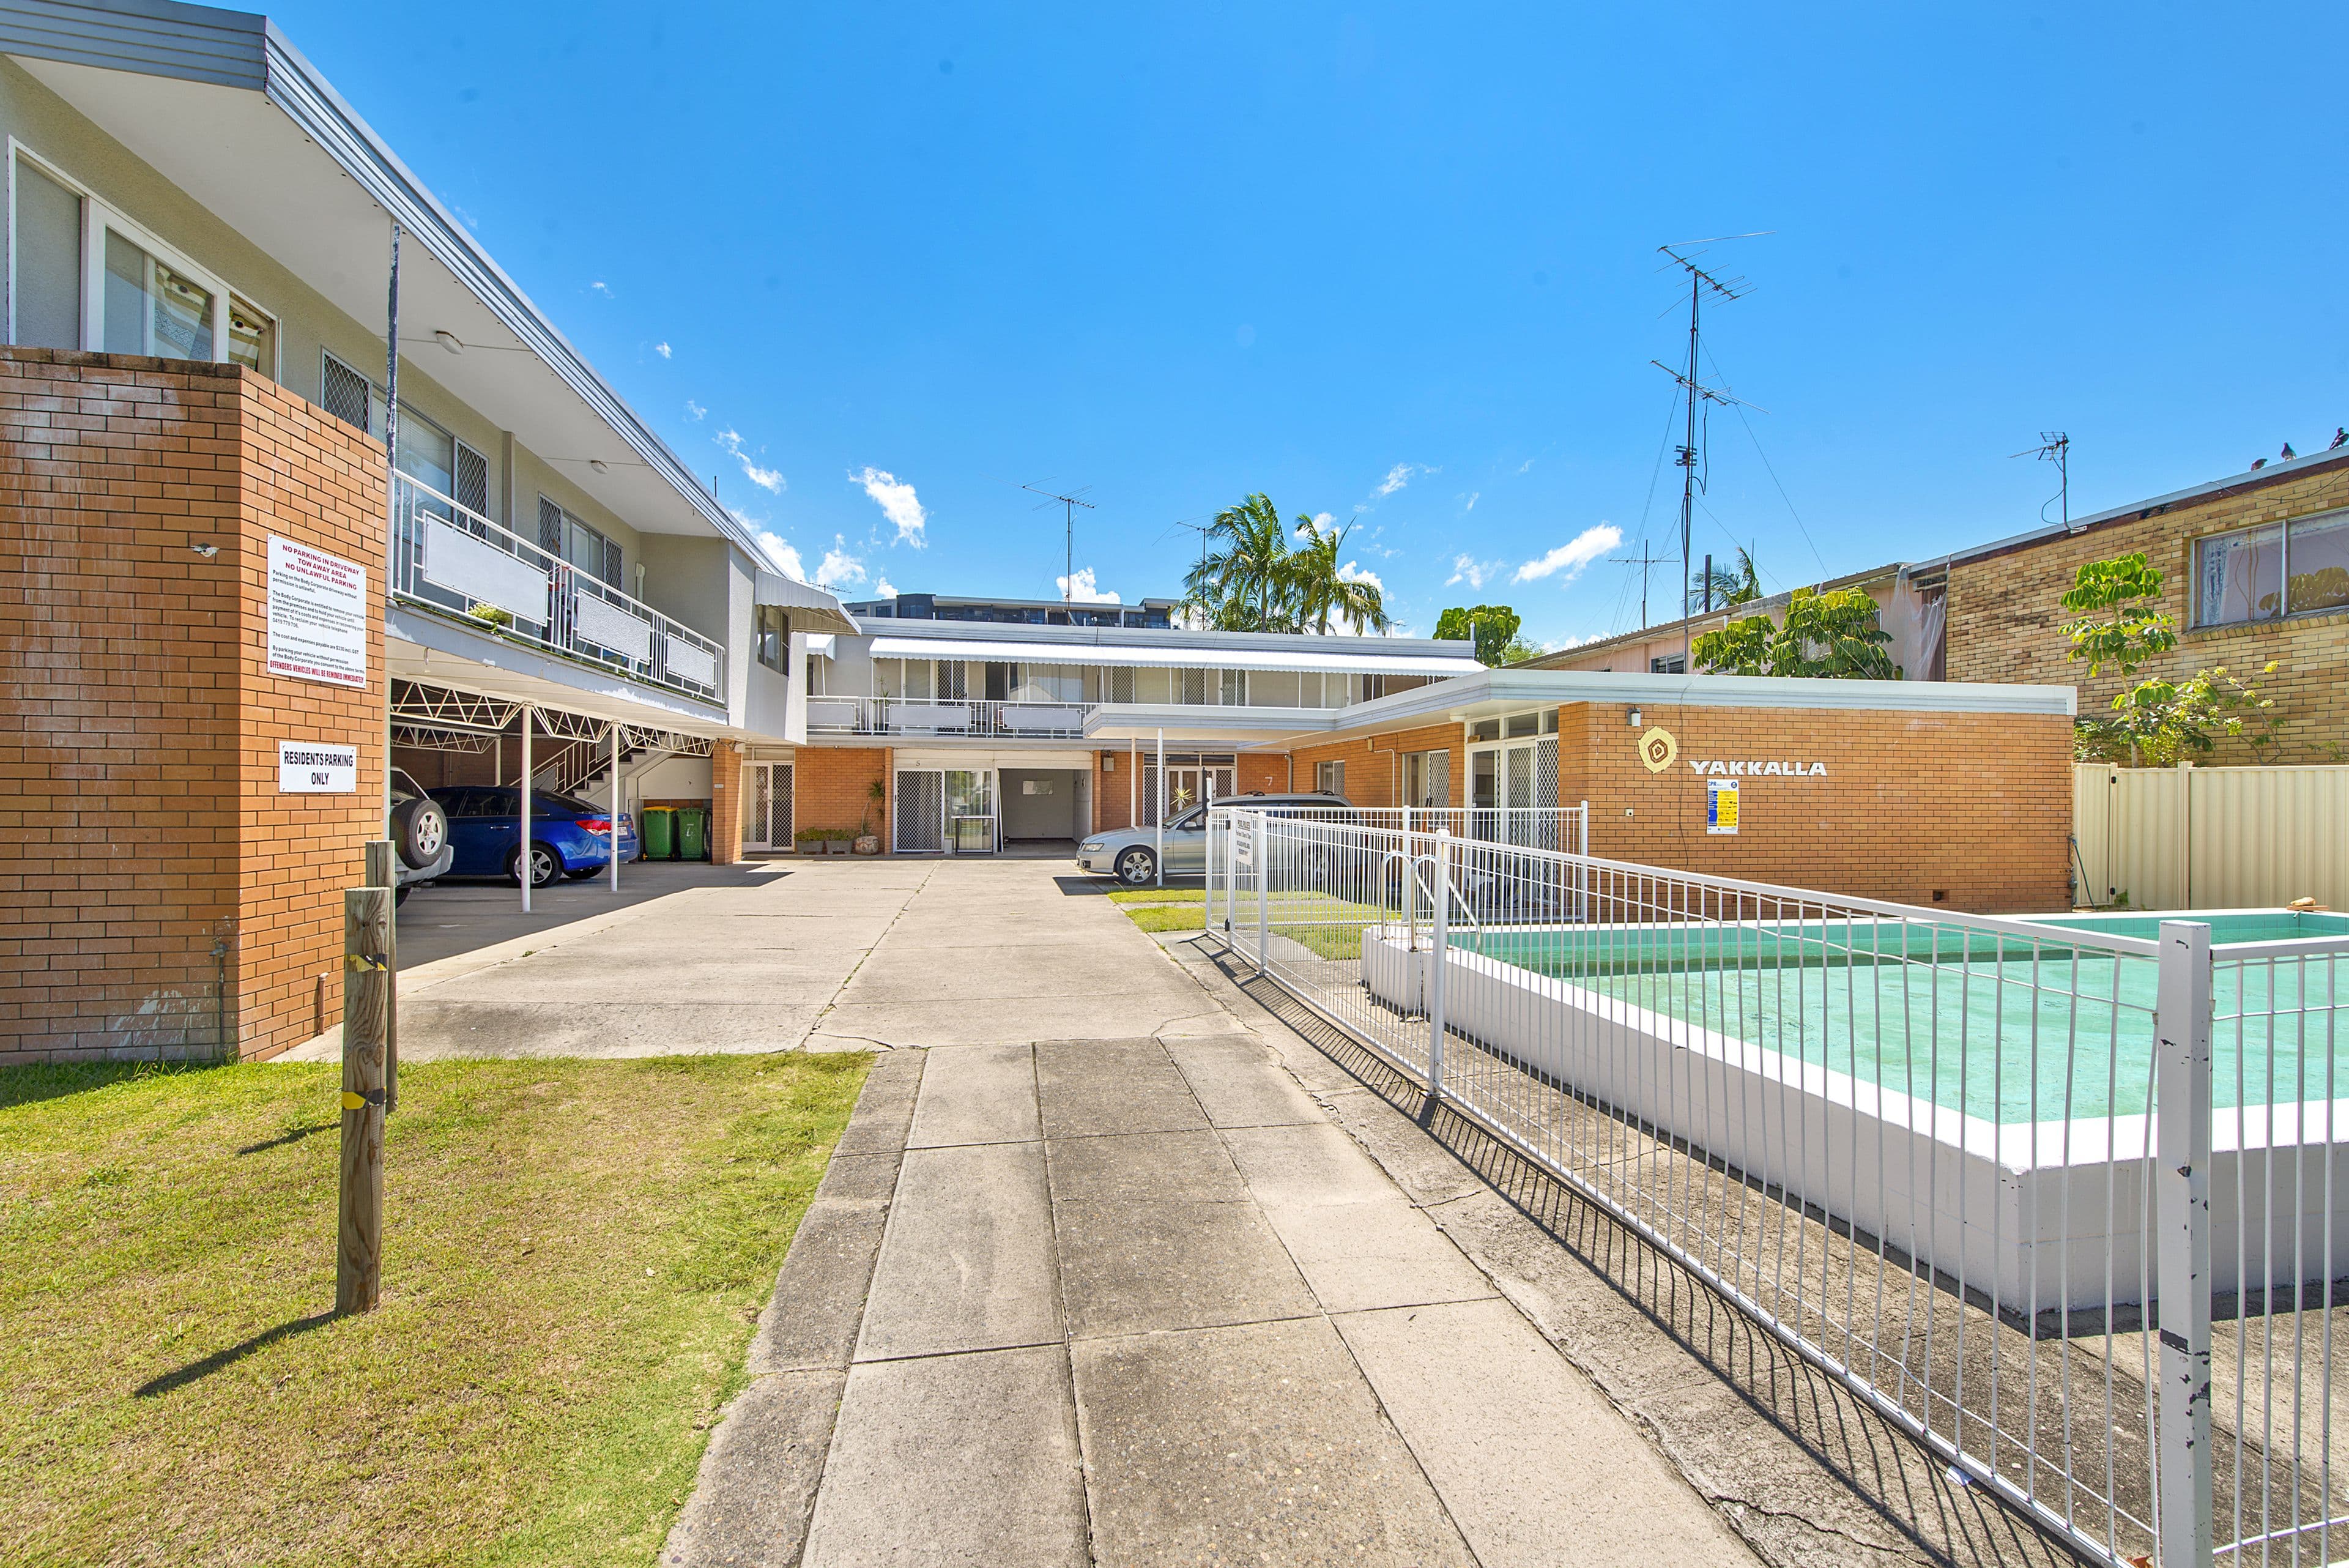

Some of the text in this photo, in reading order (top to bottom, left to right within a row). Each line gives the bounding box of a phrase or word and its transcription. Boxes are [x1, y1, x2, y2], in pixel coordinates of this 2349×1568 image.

[294, 548, 321, 562] PARKING
[330, 561, 359, 575] DRIVEWAY
[298, 558, 347, 579] TOW AWAY AREA
[273, 578, 294, 587] permission
[273, 570, 288, 579] Parking
[311, 581, 328, 590] Corporate
[329, 587, 344, 596] driveway
[297, 566, 330, 582] UNLAWFUL
[332, 578, 357, 590] PARKING
[292, 596, 310, 605] Corporate
[270, 660, 292, 671] OFFENDERS
[293, 664, 311, 674] VEHICLES
[326, 671, 343, 680] REMOVED
[343, 674, 364, 683] IMMEDIATELY
[284, 751, 353, 767] RESIDENTS PARKING
[1688, 760, 1828, 776] YAKKALLA
[311, 772, 329, 786] ONLY
[1264, 776, 1273, 787] 7
